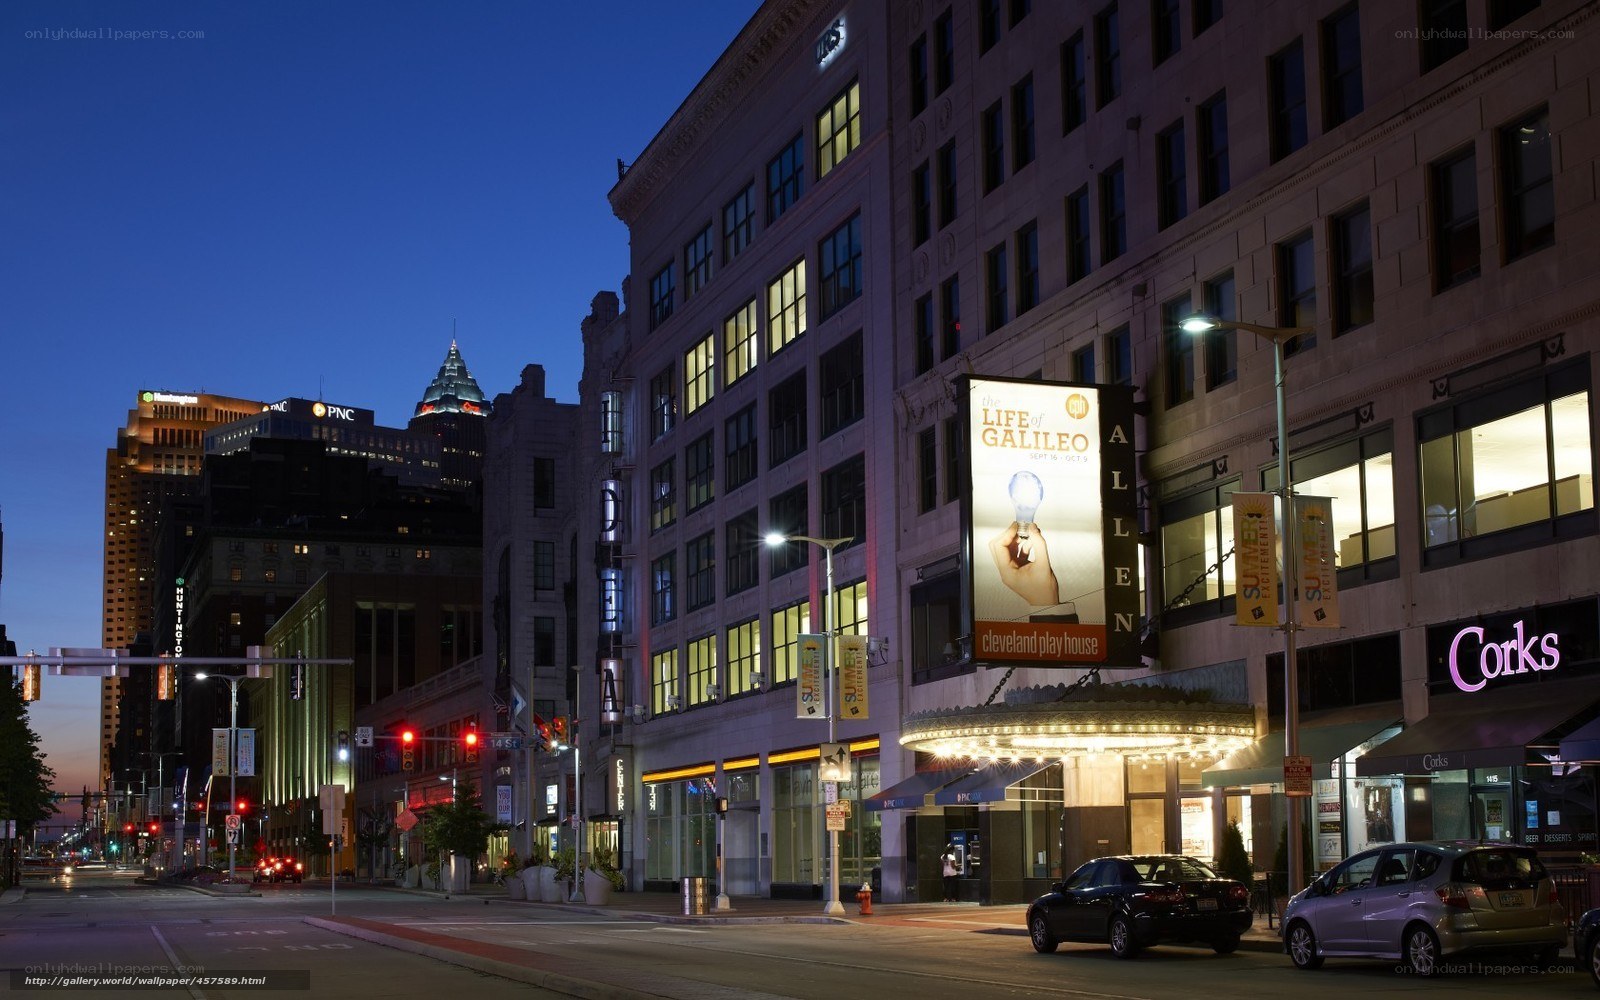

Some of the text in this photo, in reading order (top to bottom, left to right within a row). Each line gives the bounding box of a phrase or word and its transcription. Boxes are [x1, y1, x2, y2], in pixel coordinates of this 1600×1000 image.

[327, 406, 355, 421] PNC
[982, 394, 1001, 408] the
[982, 408, 1046, 428] LIFE of
[982, 427, 1089, 453] GALILEO
[1050, 453, 1058, 461] 16
[1109, 425, 1133, 632] ALLEN
[1243, 518, 1260, 600] SUMMER
[982, 629, 1098, 657] cleveland play house
[1449, 620, 1560, 692] Corks
[802, 648, 813, 702] SUMMER
[844, 651, 857, 702] SUMMER
[491, 739, 502, 748] 14
[504, 738, 518, 748] St
[1423, 754, 1449, 770] Corks
[616, 759, 625, 811] CENTER
[1525, 834, 1539, 843] BEER
[1544, 833, 1572, 842] DESSERTS
